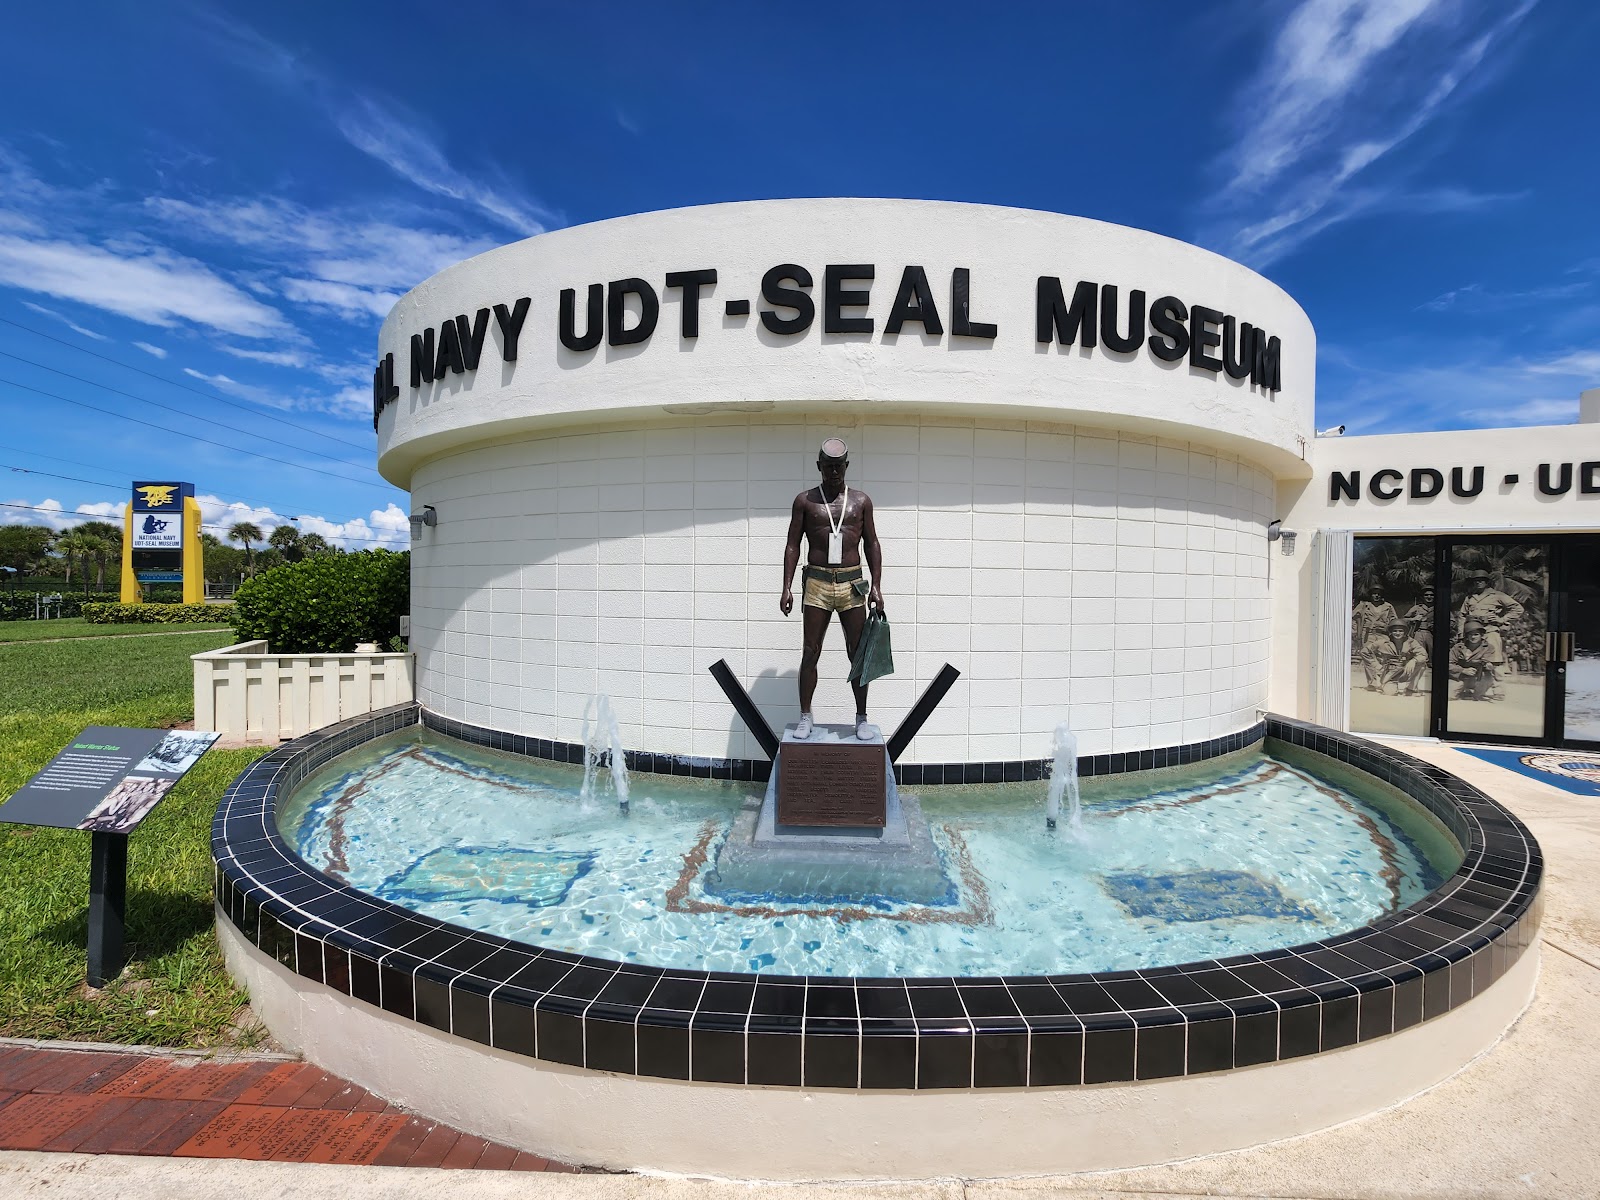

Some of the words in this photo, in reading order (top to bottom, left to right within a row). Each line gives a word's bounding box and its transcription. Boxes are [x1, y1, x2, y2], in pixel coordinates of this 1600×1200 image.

[410, 297, 531, 388] NAVY
[560, 264, 997, 352] UDT-SEAL
[1037, 276, 1281, 392] MUSEUM
[1331, 466, 1484, 500] NCDU
